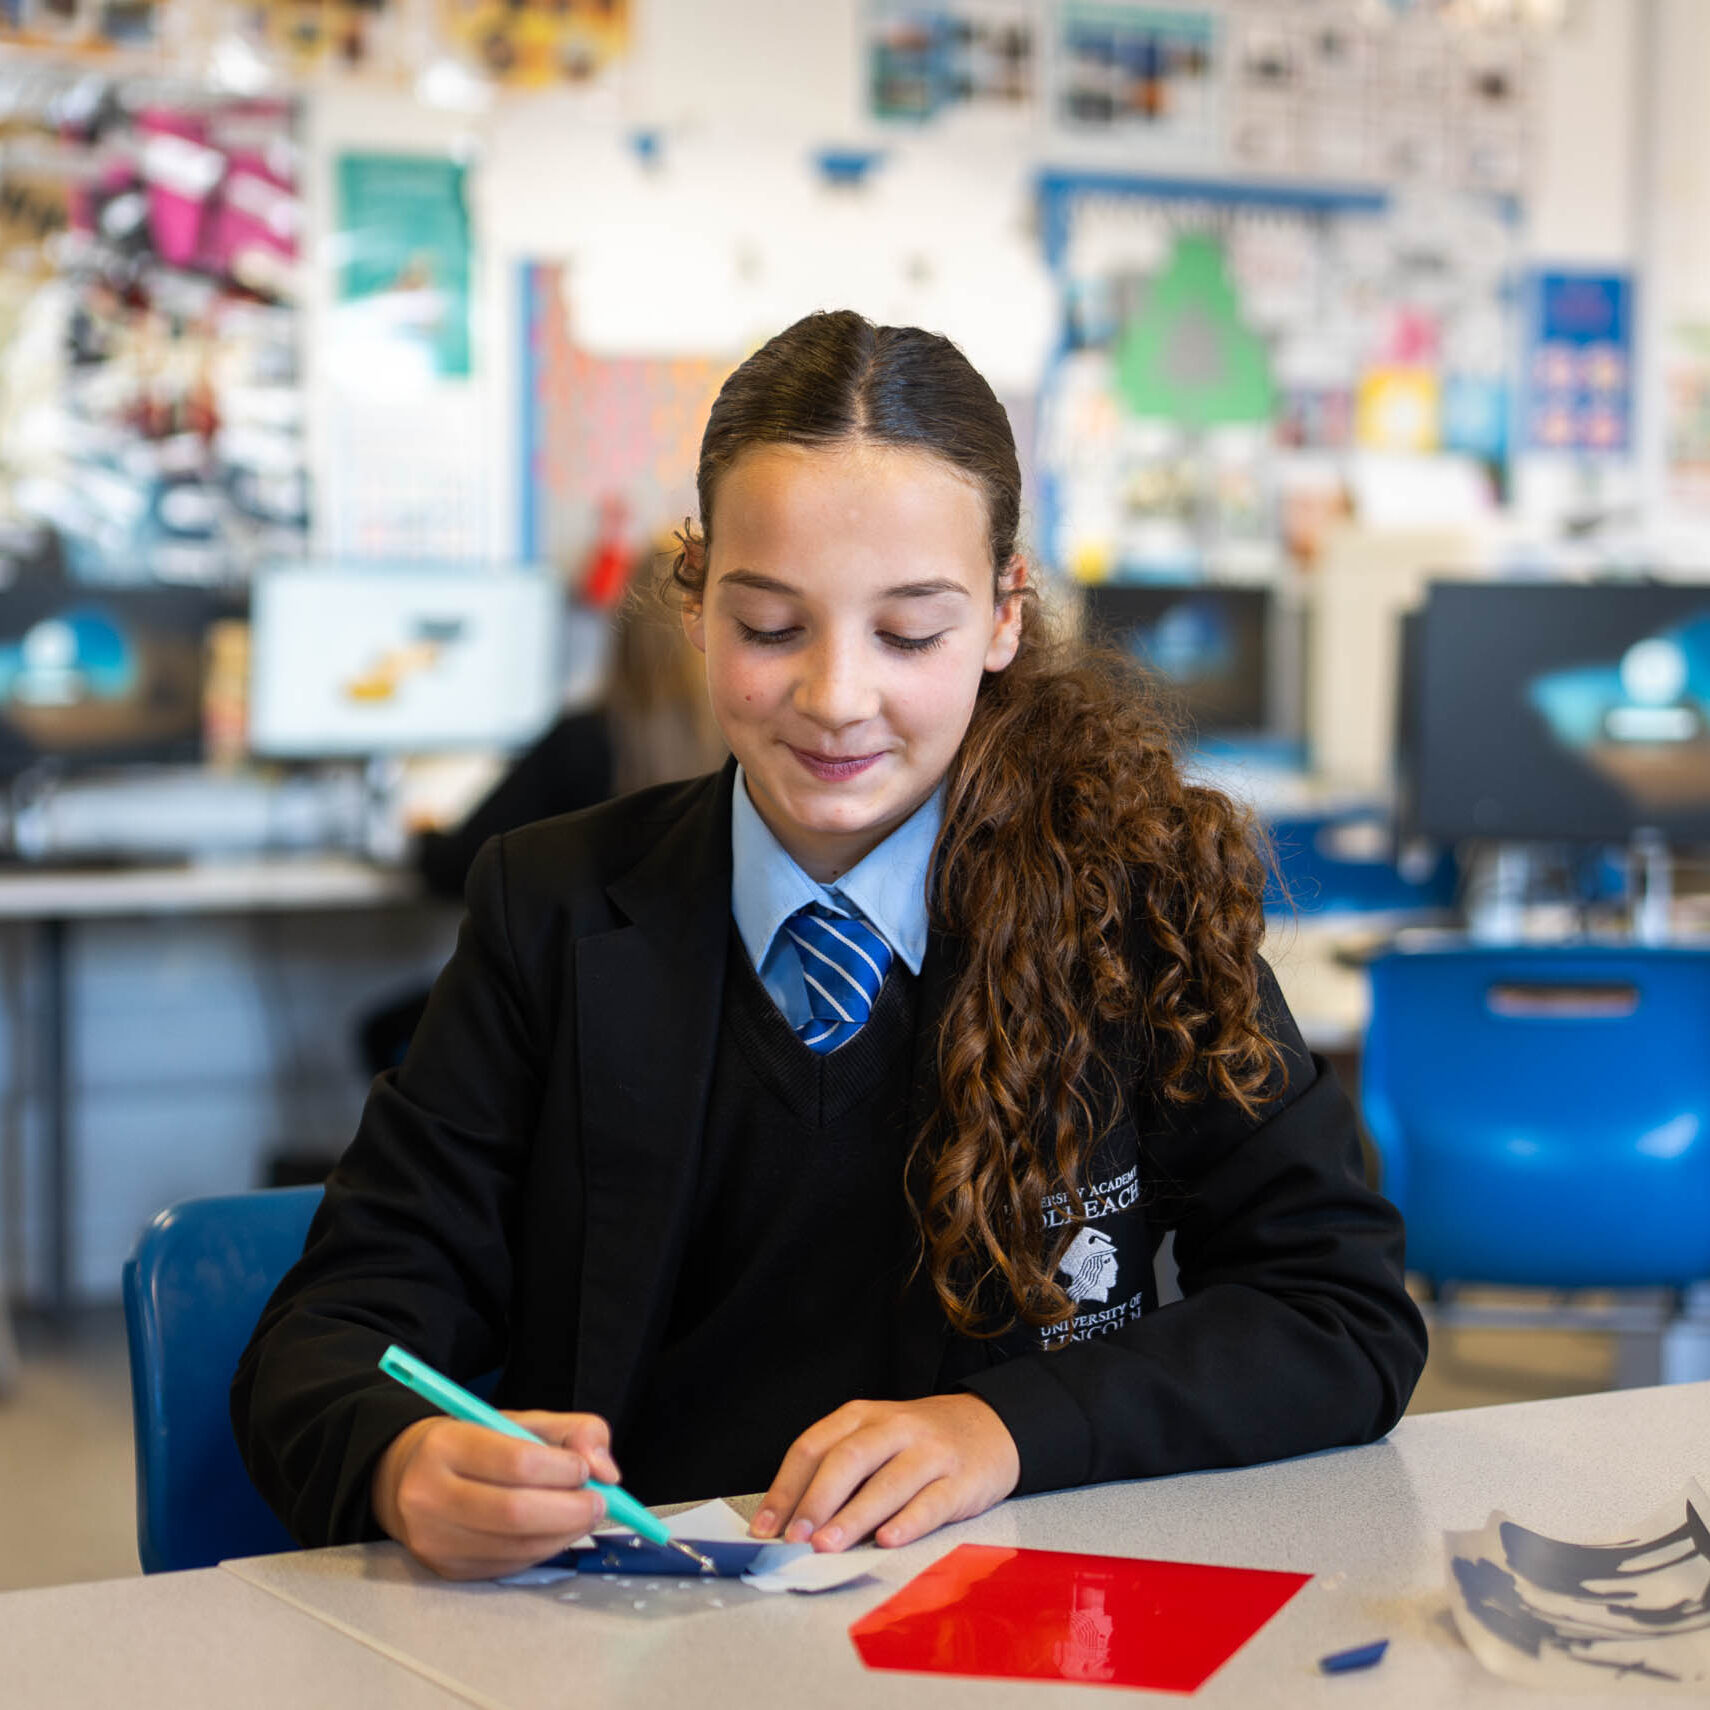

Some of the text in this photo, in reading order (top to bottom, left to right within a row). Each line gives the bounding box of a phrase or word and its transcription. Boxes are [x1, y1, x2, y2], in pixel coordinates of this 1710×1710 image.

[1041, 1179, 1140, 1229] LEACH
[1041, 1292, 1143, 1337] UNIVERSITY OF
